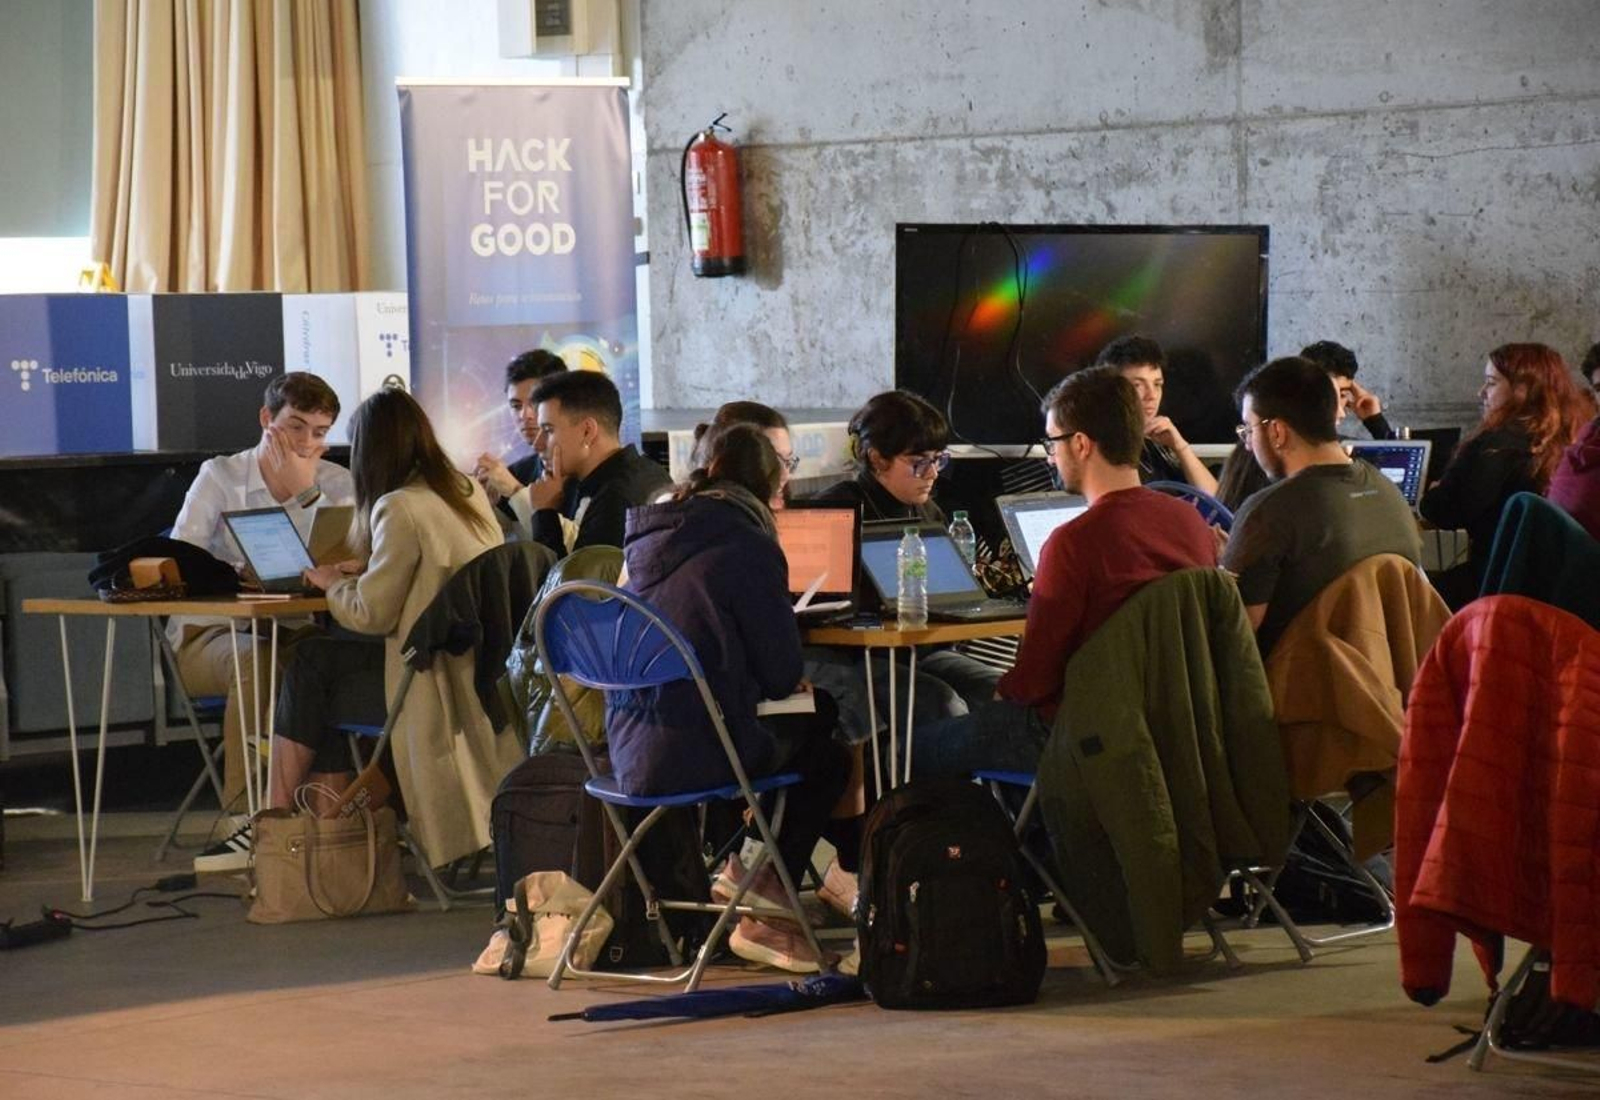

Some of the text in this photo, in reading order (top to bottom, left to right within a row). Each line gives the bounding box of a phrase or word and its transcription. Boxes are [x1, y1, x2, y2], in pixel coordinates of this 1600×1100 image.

[467, 137, 573, 172] HACK
[483, 180, 560, 216] FOR
[470, 222, 576, 257] GOOD
[41, 366, 118, 385] Telefónica
